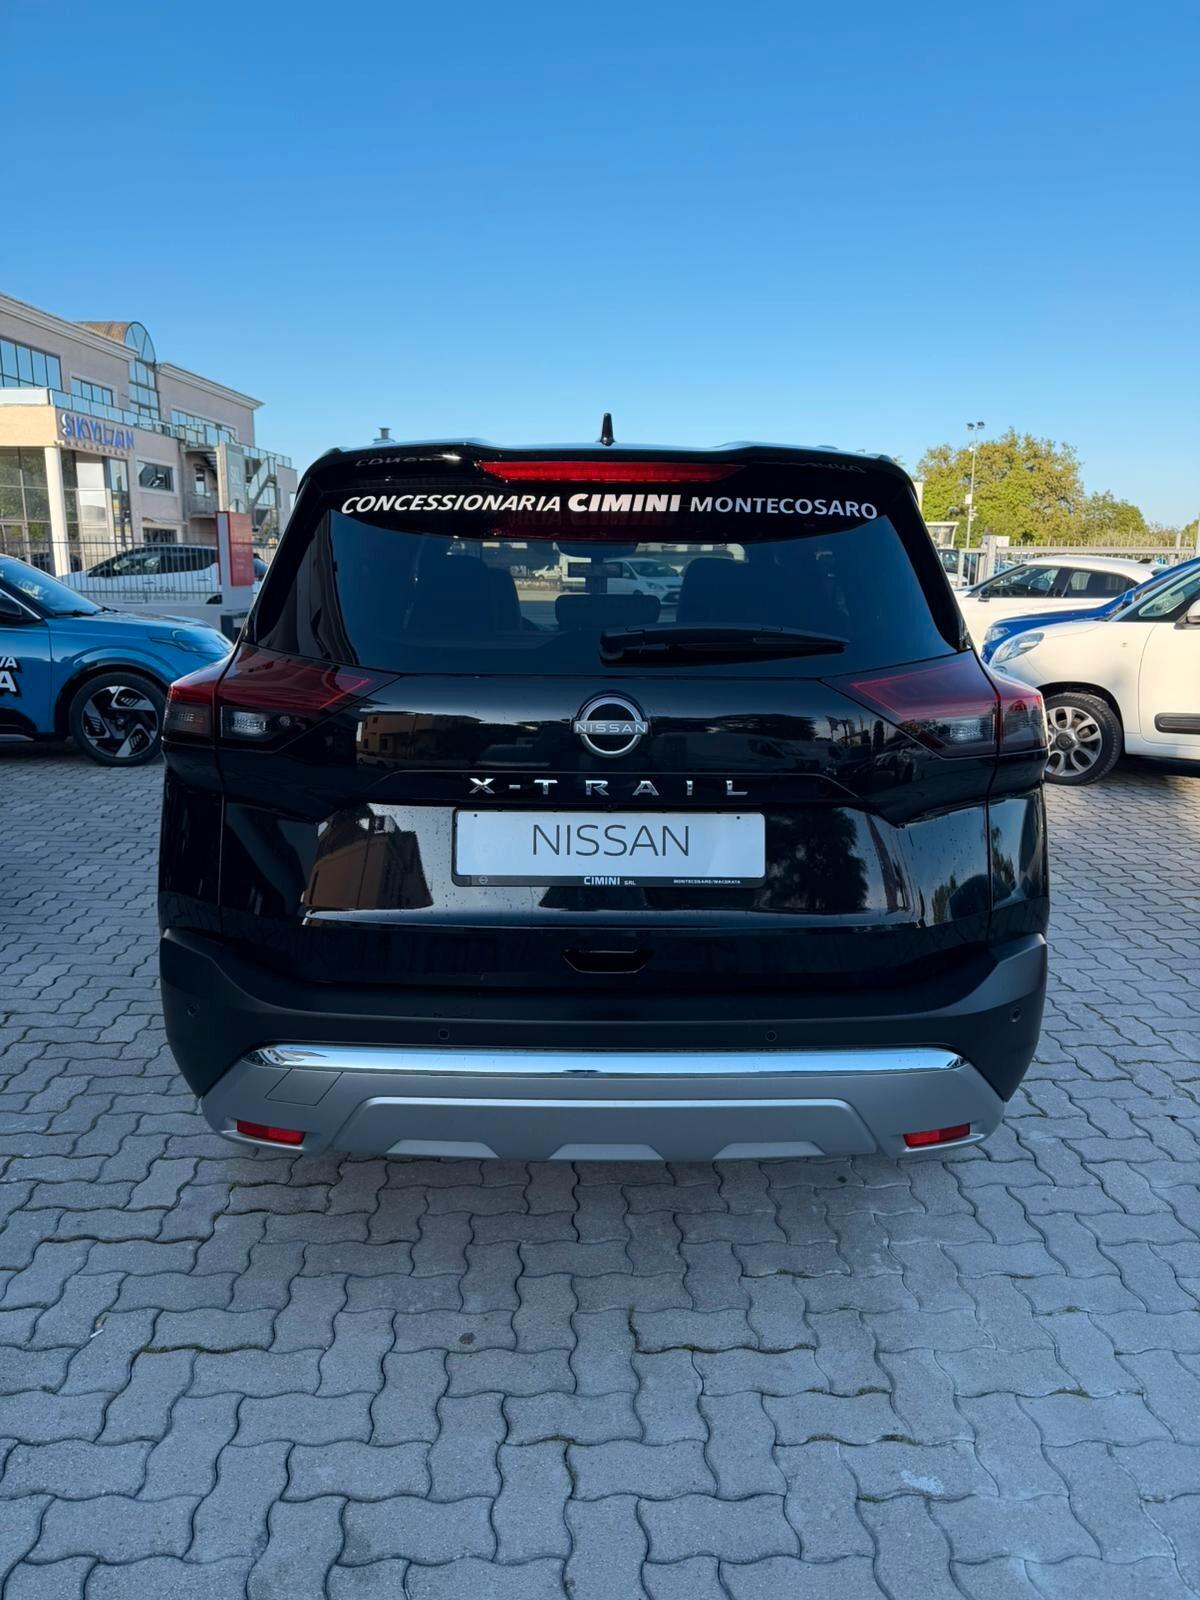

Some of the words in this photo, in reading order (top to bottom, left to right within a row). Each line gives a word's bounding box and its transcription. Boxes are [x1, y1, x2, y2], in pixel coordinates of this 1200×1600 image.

[340, 494, 561, 514] CONCESSIONARIA
[567, 492, 682, 513] CIMINI
[689, 496, 878, 520] MONTECOSARO
[575, 722, 647, 733] NISSAN
[468, 777, 749, 797] X-TRAIL
[532, 824, 690, 857] NISSAN
[583, 875, 621, 886] CIMINI
